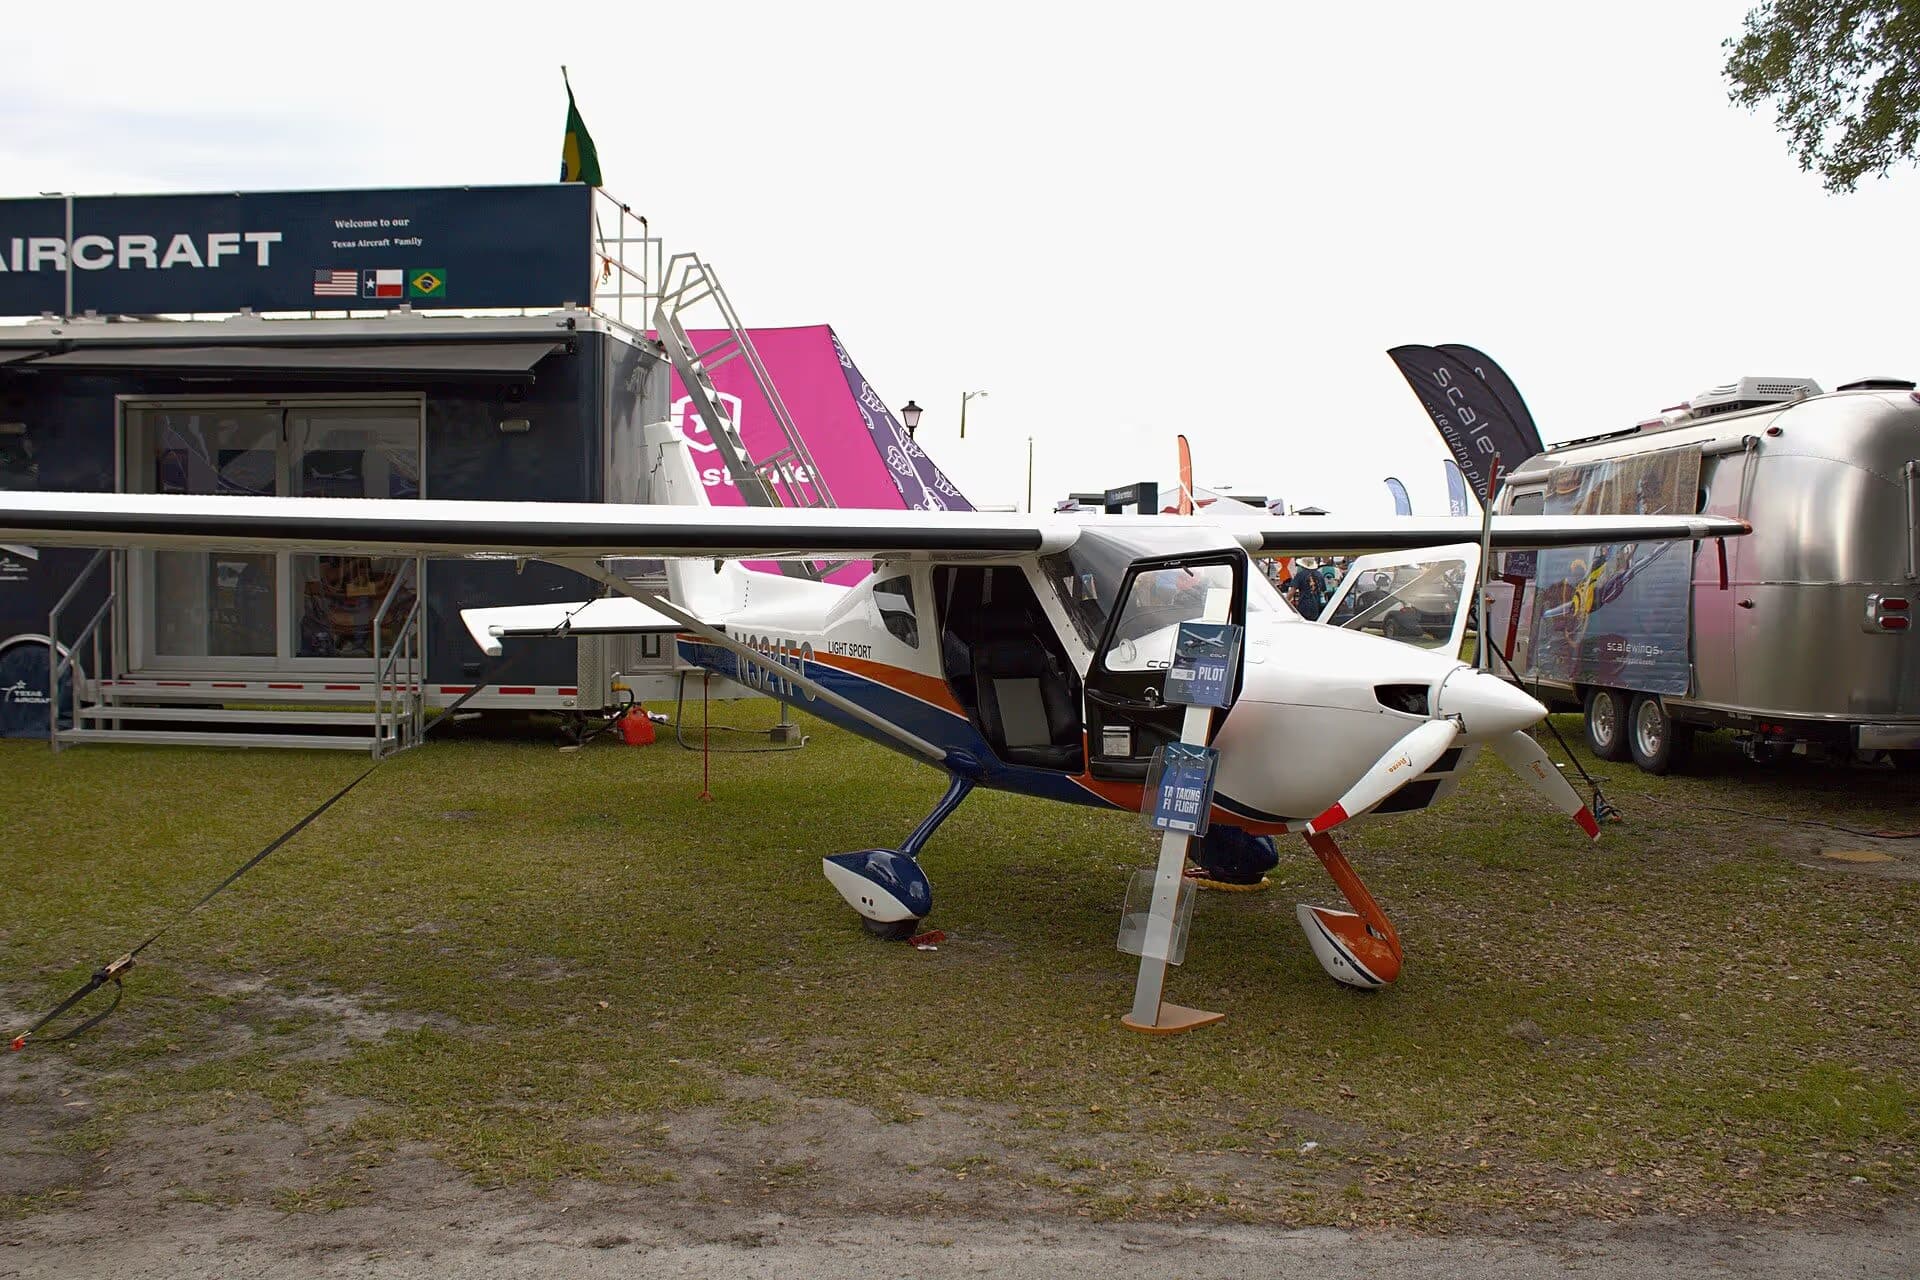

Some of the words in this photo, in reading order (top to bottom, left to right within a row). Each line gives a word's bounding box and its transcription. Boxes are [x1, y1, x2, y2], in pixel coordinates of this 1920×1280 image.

[335, 219, 378, 229] Welcome
[380, 218, 390, 227] to
[392, 218, 410, 226] our
[331, 240, 356, 248] Texas
[357, 238, 390, 247] Aircraft
[393, 237, 422, 246] Family
[0, 231, 282, 271] IRCRAFT
[1466, 470, 1490, 501] pilo
[827, 640, 848, 656] LIGHT
[848, 643, 872, 659] SPORT
[1198, 666, 1225, 681] PILOT
[1175, 787, 1200, 801] TAKING
[1174, 800, 1200, 815] FLIGHT
